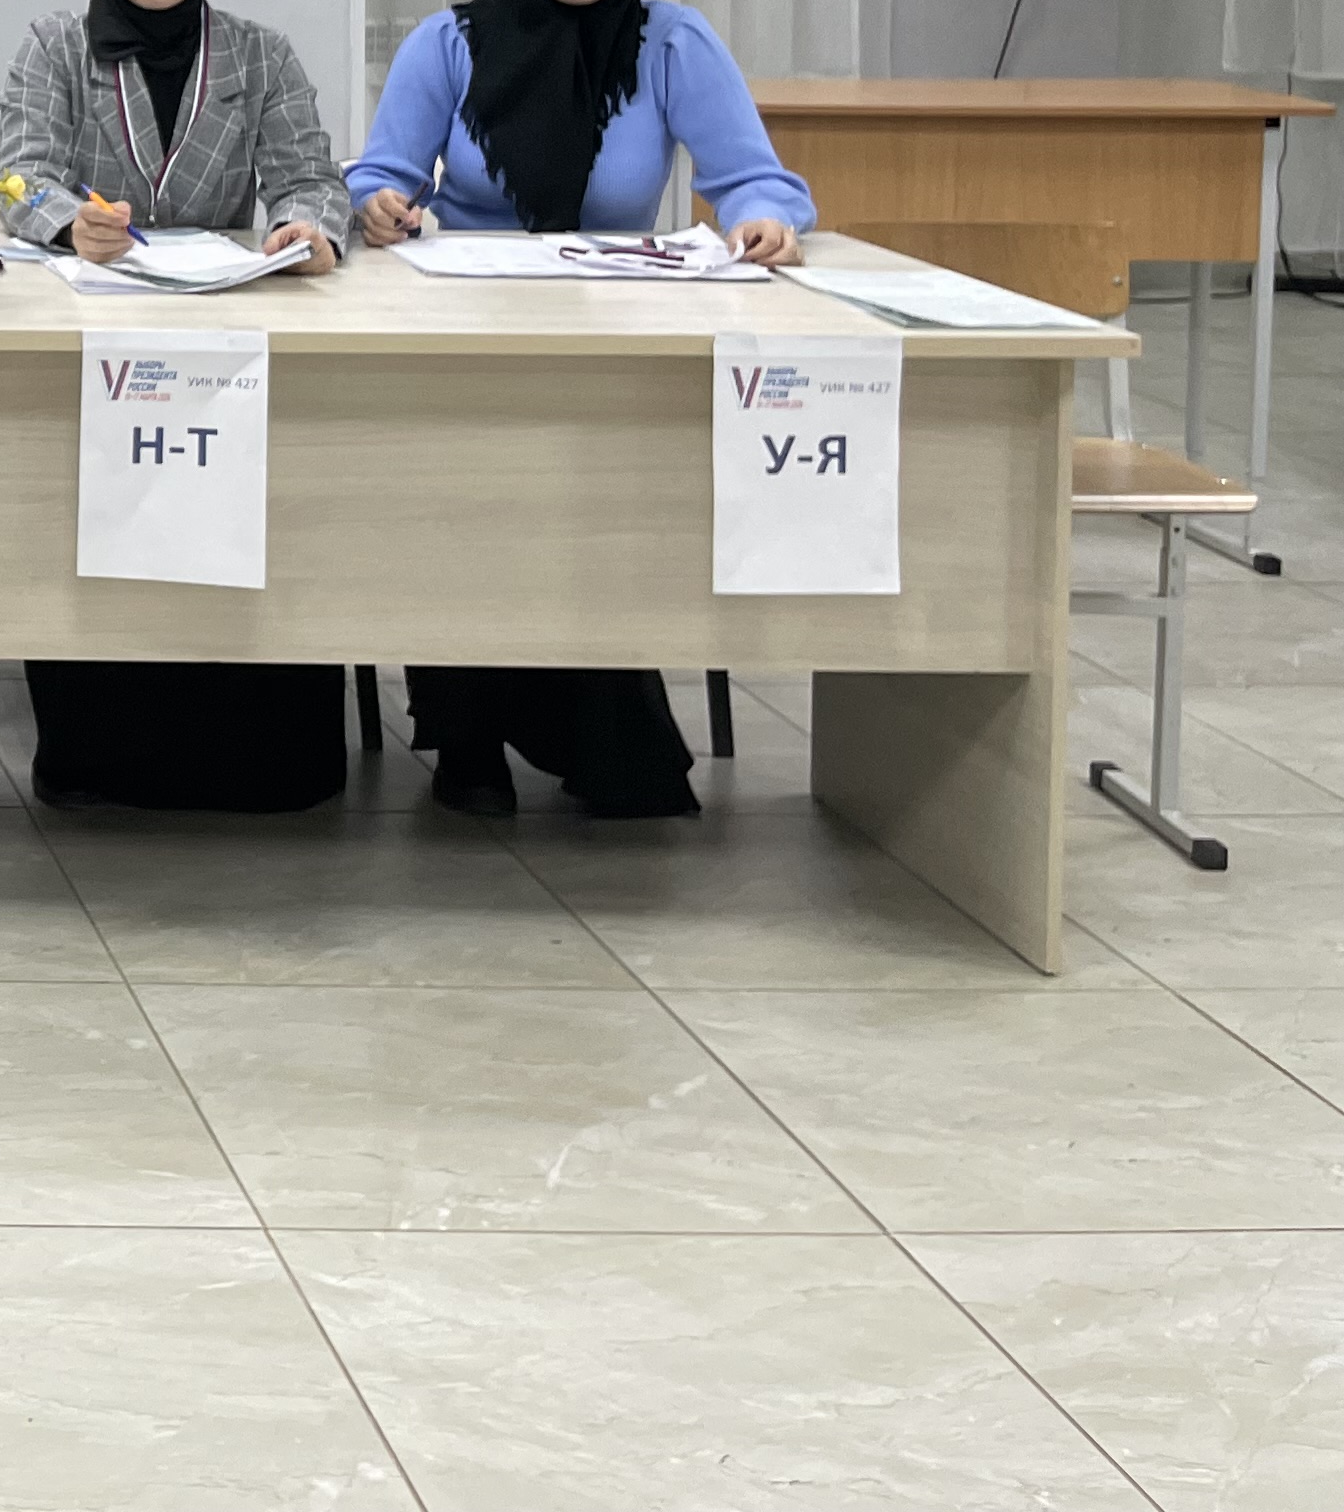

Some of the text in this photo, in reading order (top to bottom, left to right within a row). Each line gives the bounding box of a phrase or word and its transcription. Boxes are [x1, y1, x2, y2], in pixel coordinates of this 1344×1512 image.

[132, 370, 178, 380] ПРЕЗИДЕНТА
[127, 382, 158, 392] РОССИИ
[188, 376, 259, 390] УИК № 427
[132, 426, 218, 467] Н-Т
[762, 434, 846, 474] У-Я
